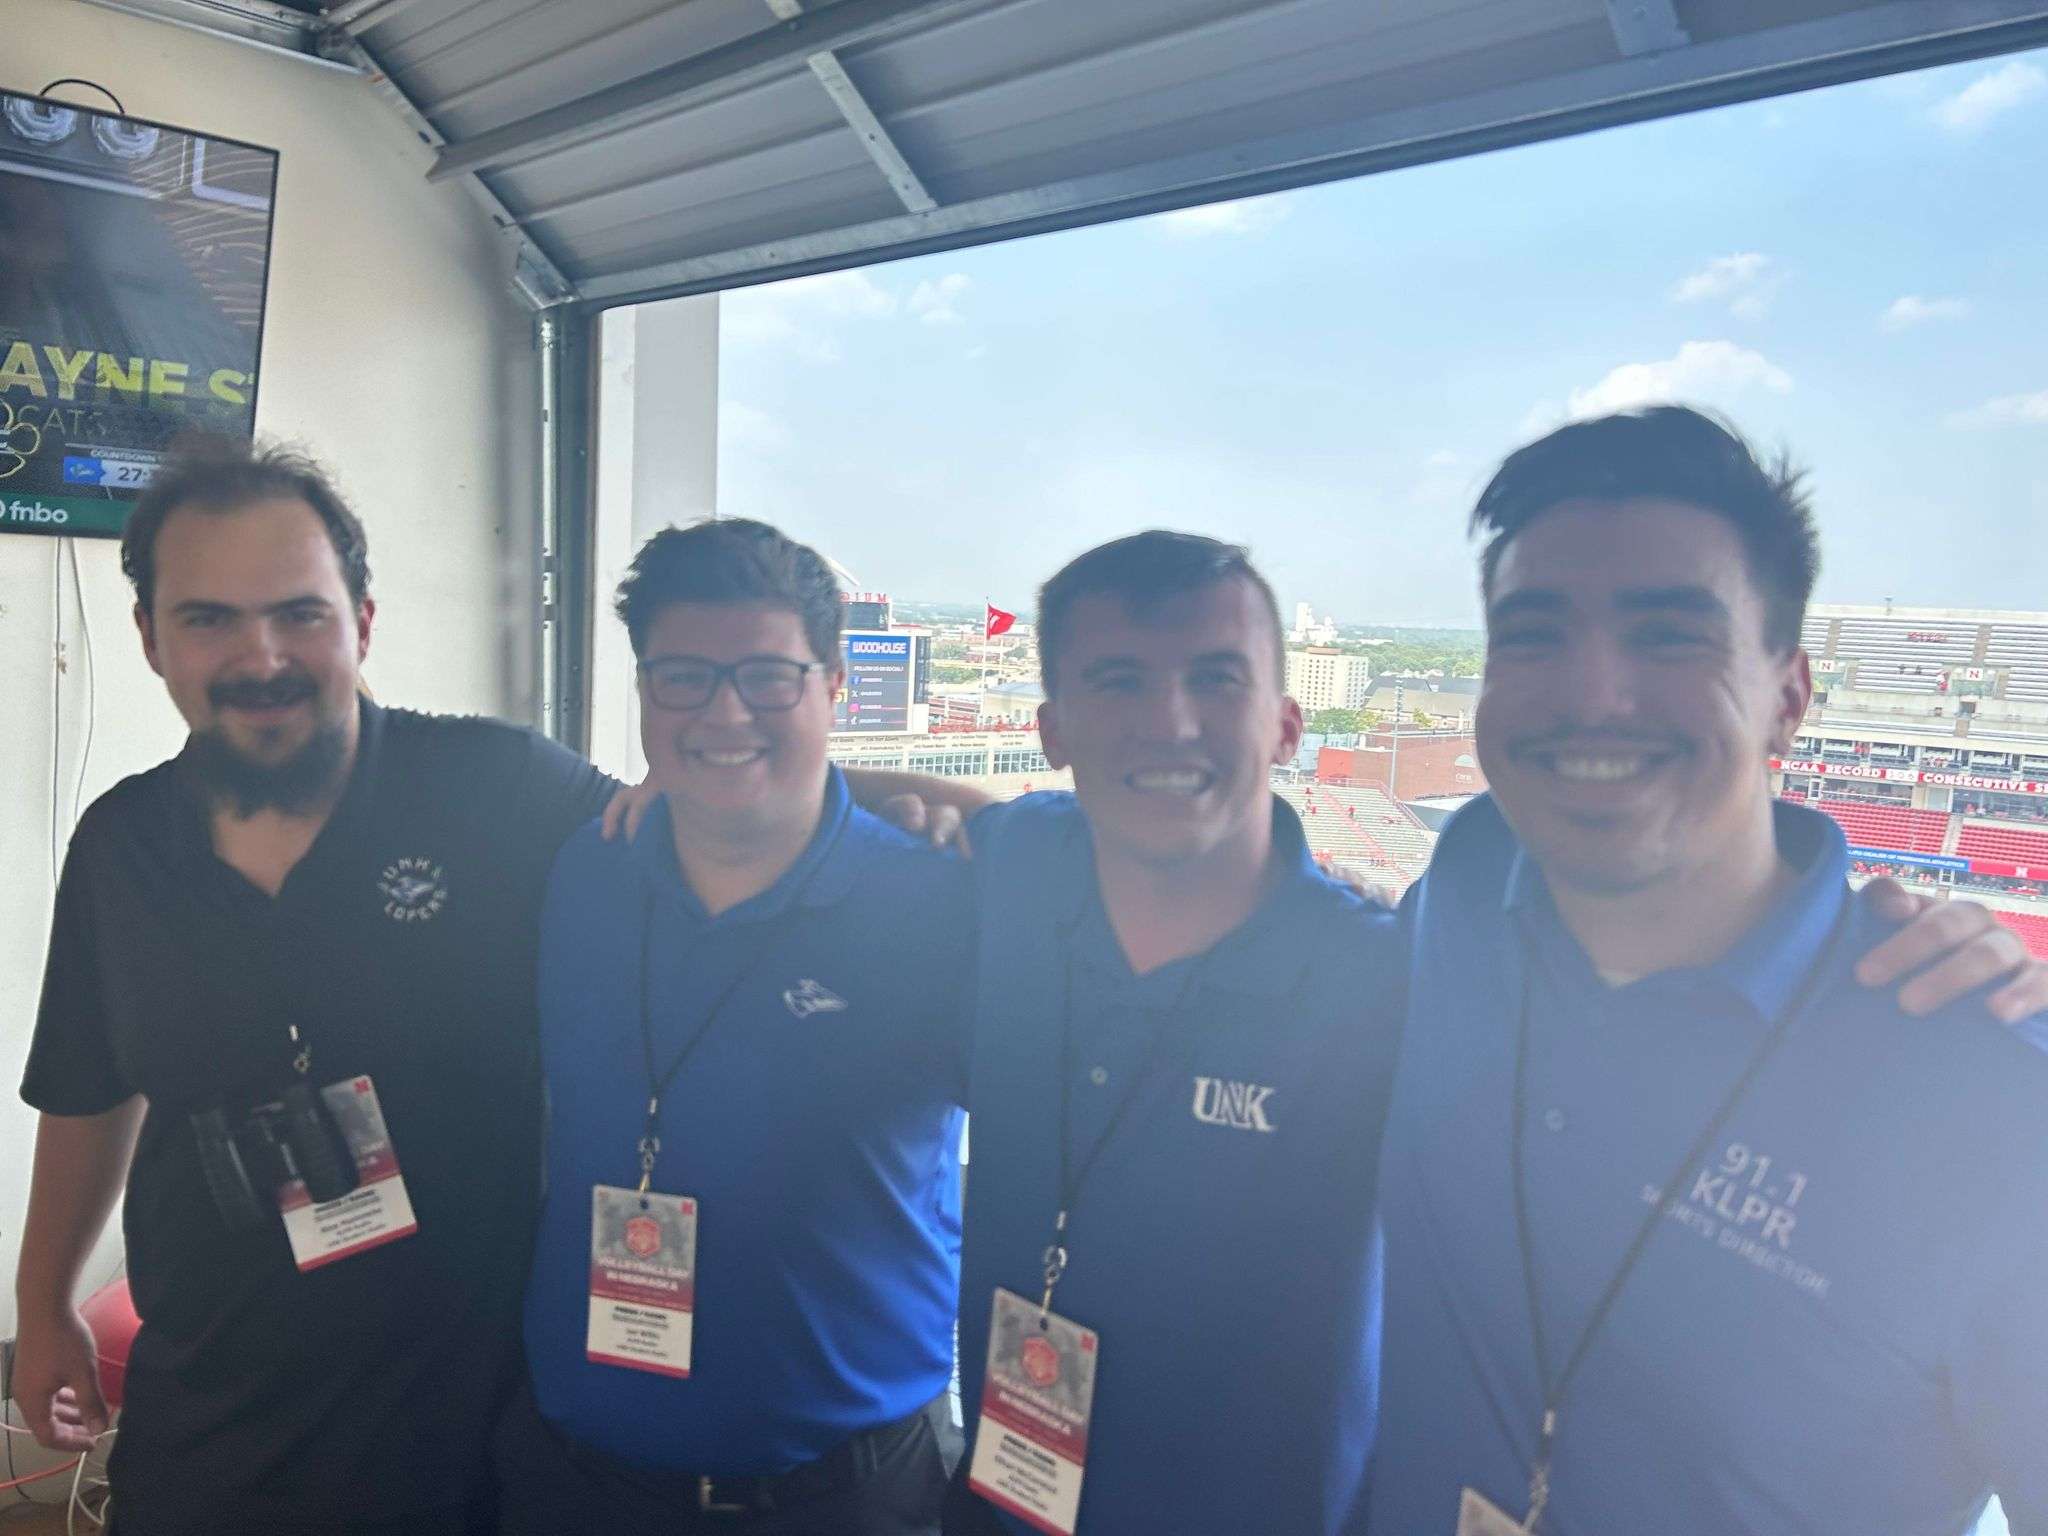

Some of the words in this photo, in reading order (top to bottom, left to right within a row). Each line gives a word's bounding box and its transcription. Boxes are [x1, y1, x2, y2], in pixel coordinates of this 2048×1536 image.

[207, 368, 255, 410] S
[9, 501, 69, 524] fnbo
[1780, 760, 1820, 773] NCAA
[1824, 764, 1882, 778] RECORD
[1922, 772, 2028, 791] CONSECUTIVE
[1193, 1077, 1278, 1131] UNK
[1719, 1143, 1807, 1207] 91.1
[1690, 1170, 1796, 1248] KLPR
